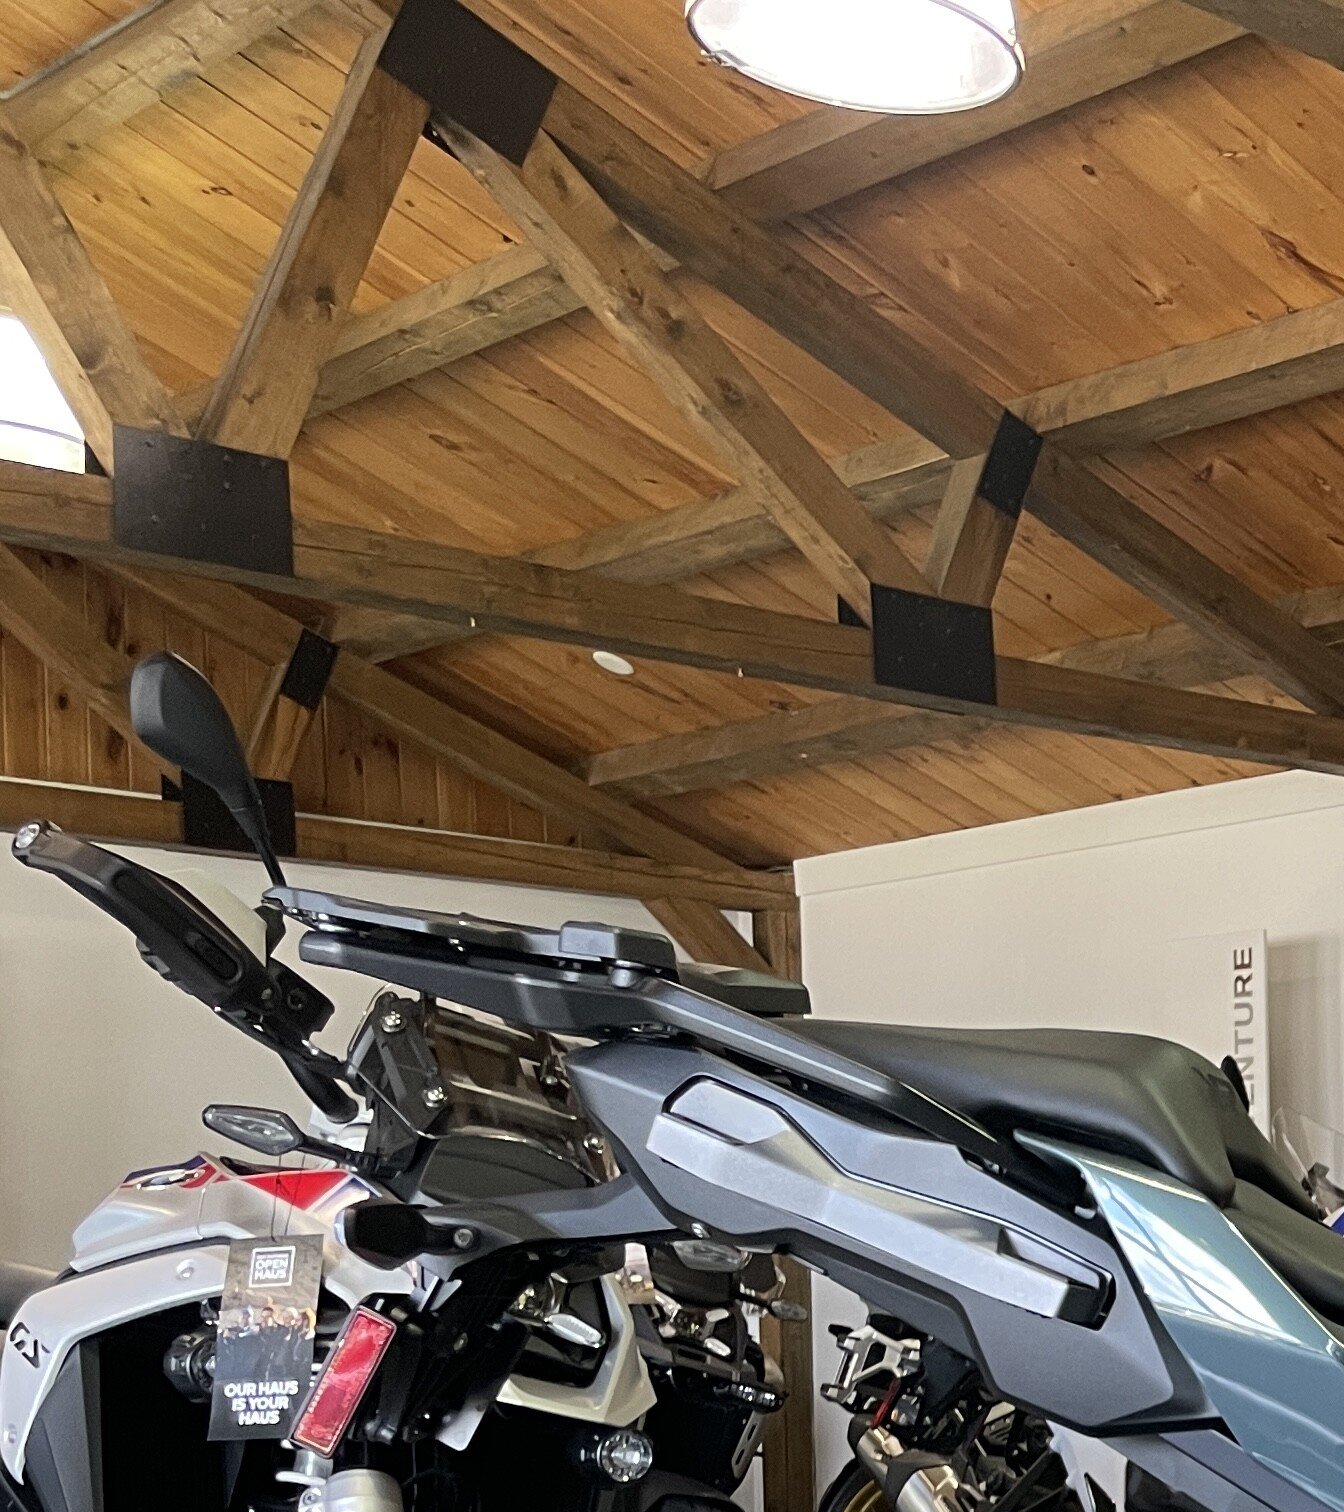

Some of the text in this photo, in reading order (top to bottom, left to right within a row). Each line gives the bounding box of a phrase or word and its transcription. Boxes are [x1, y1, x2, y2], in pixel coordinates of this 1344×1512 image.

[1233, 946, 1255, 1106] NTURE
[256, 1258, 288, 1270] OPEN
[254, 1268, 287, 1281] HAUS
[224, 1380, 299, 1398] OUR HAUS
[231, 1396, 289, 1412] IS YOUR
[238, 1410, 280, 1426] HAUS
